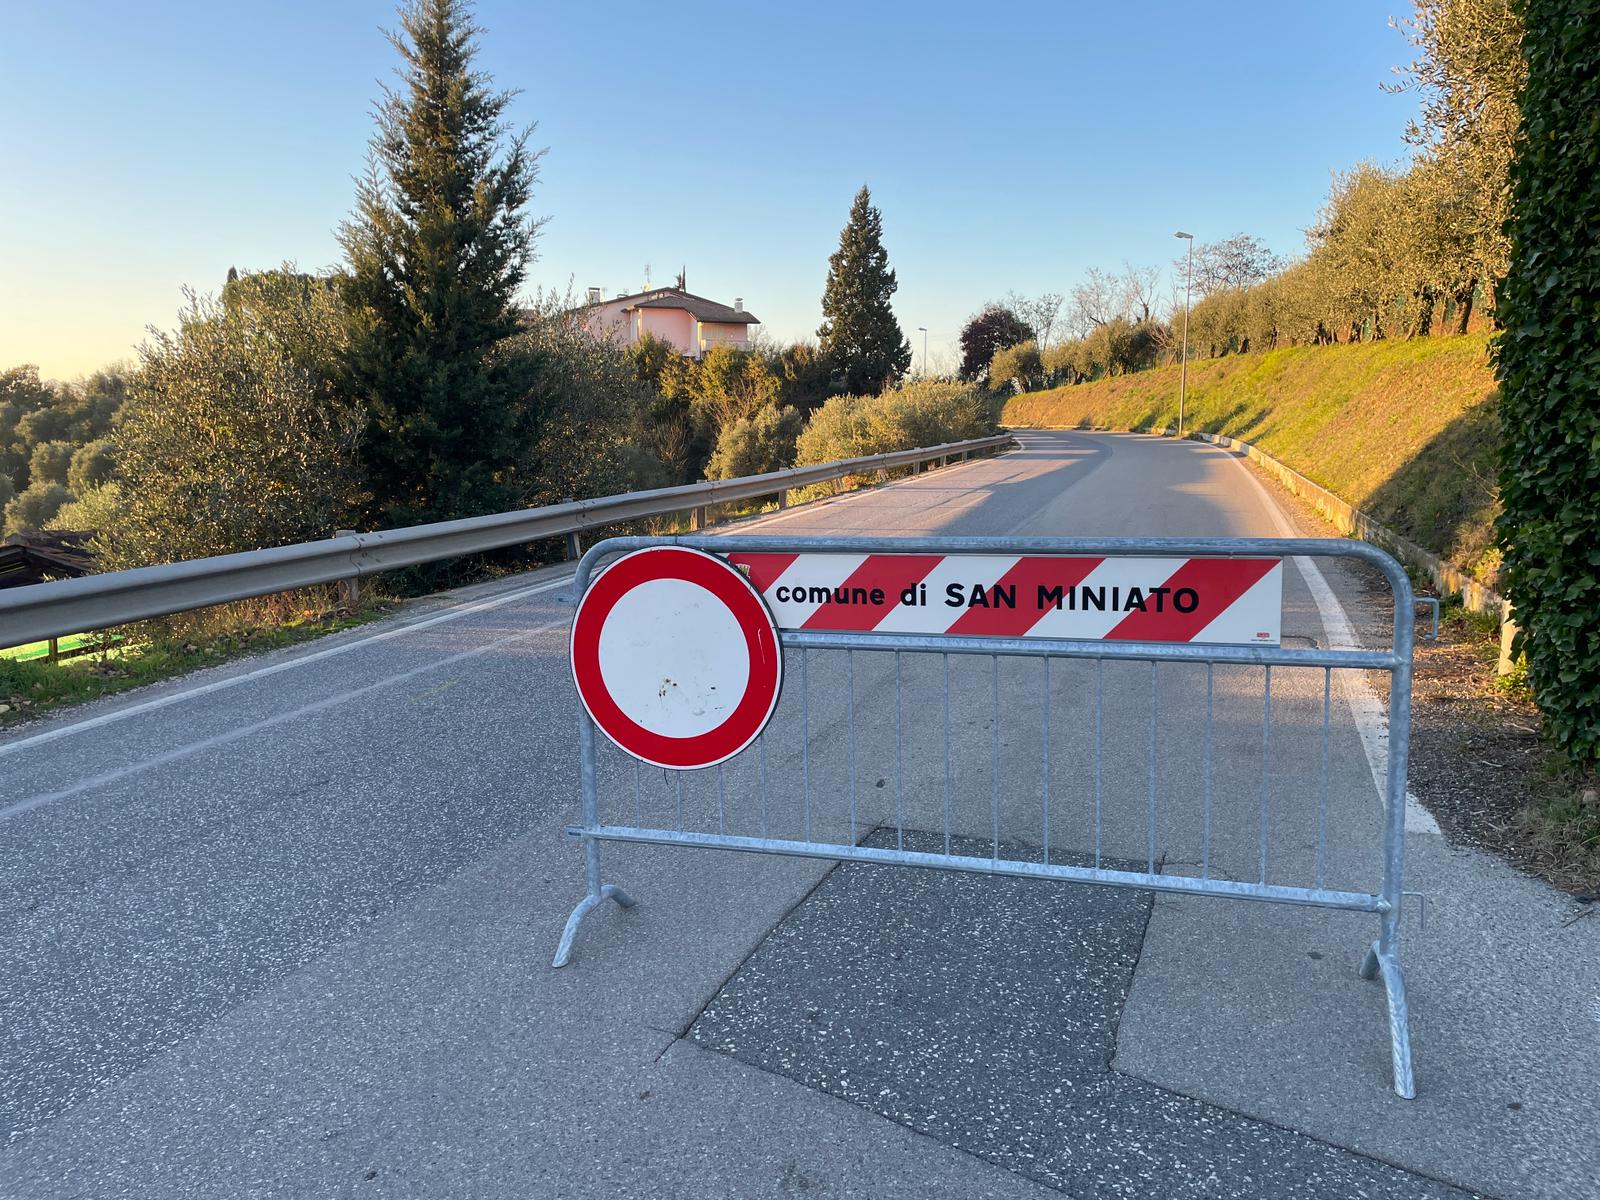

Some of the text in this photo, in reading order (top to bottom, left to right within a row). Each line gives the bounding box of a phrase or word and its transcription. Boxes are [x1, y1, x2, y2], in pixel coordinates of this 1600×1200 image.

[776, 582, 1200, 614] comune di SAN MINIATO
